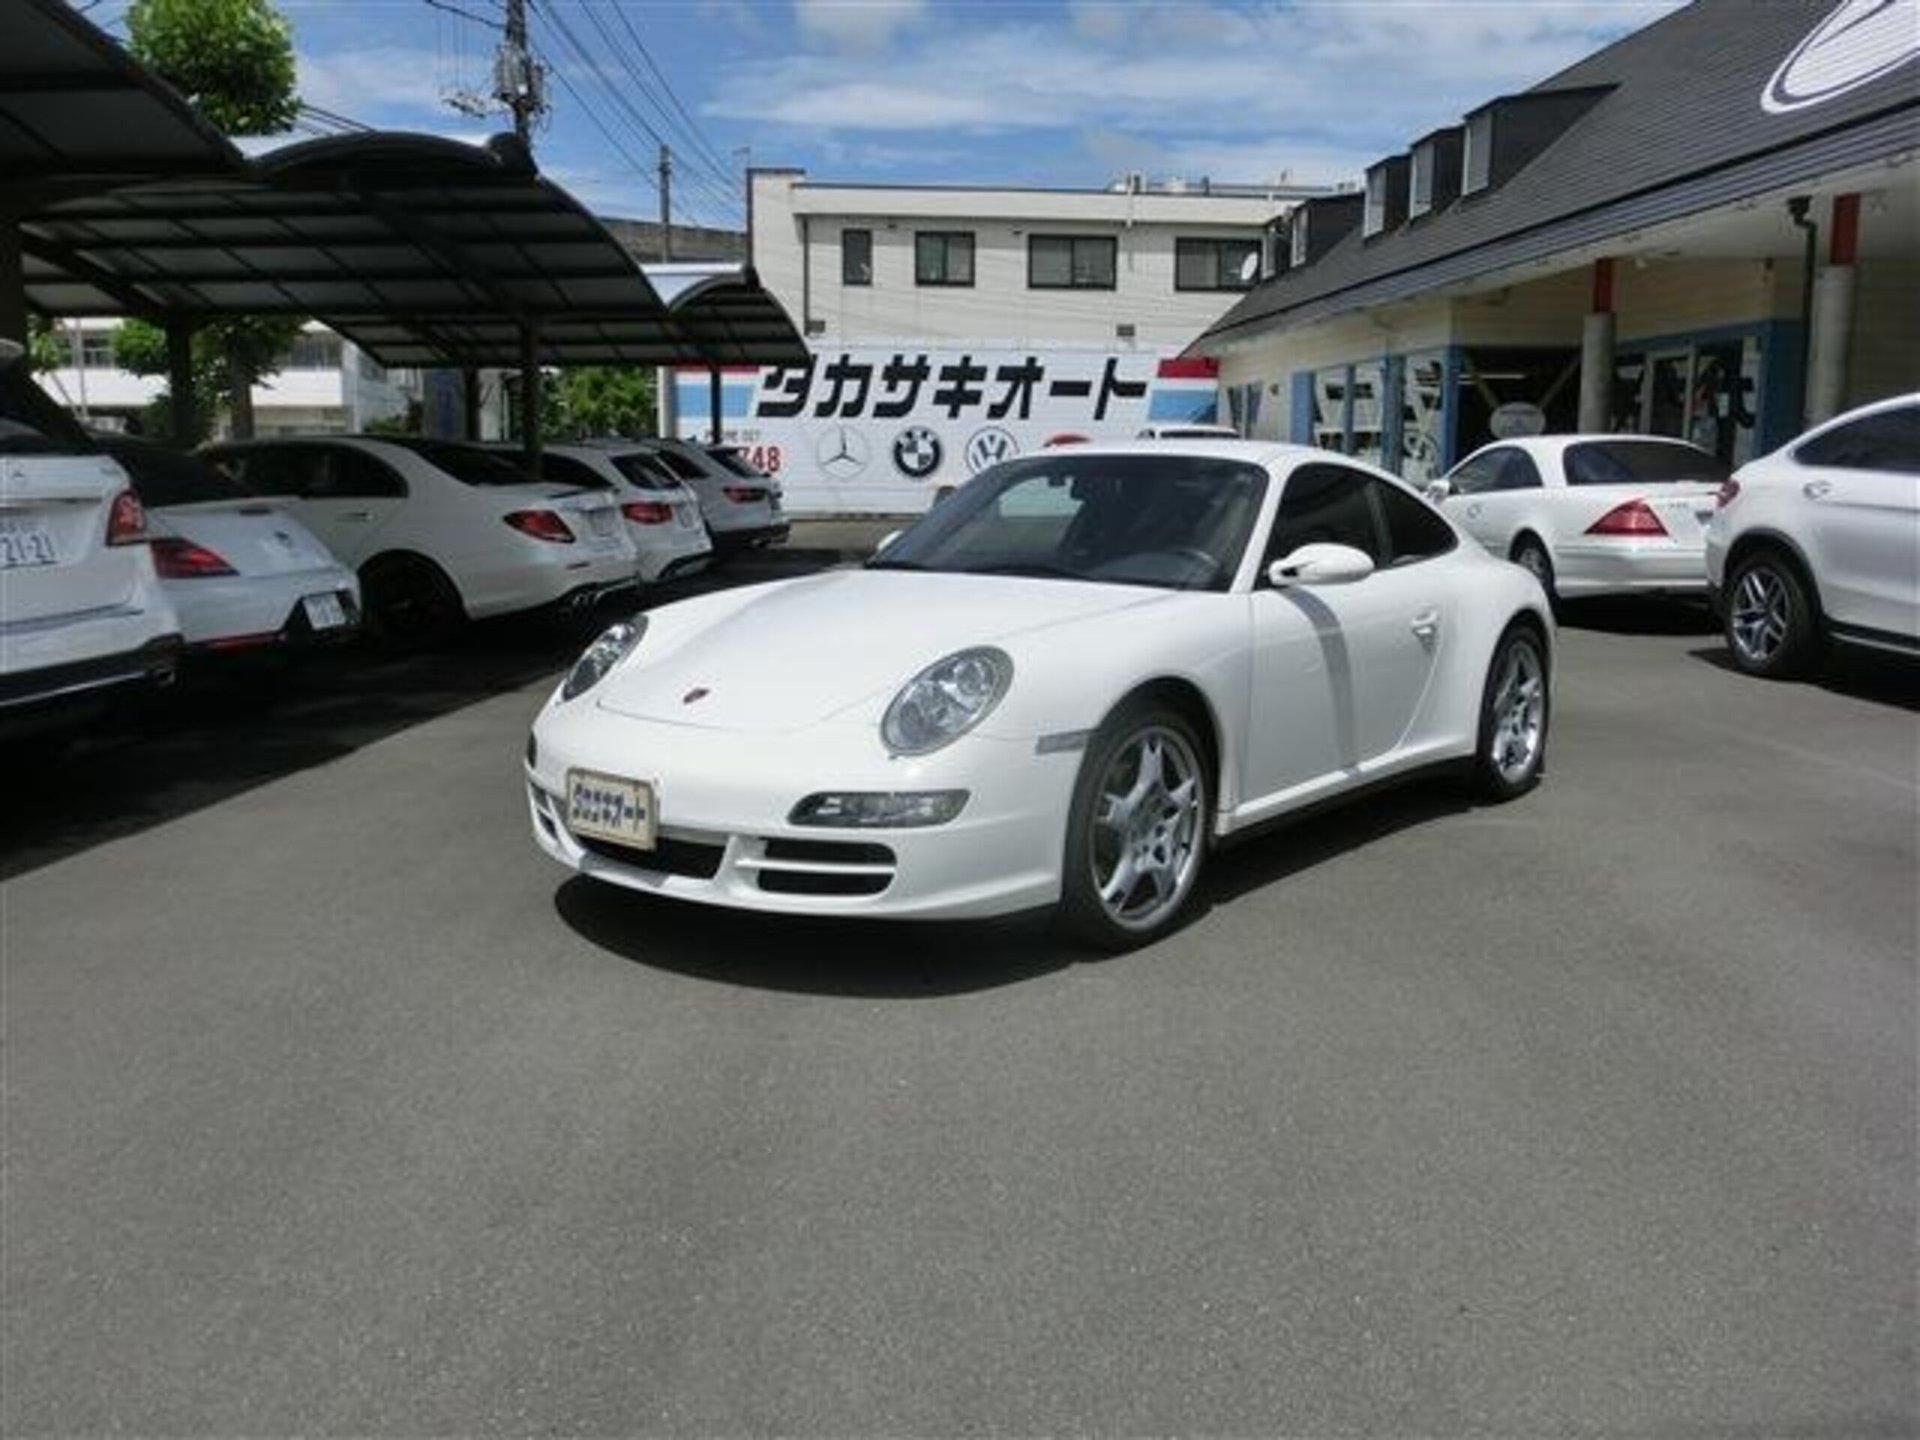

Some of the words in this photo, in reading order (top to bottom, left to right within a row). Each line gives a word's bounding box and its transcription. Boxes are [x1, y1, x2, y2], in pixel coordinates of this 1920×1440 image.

[756, 354, 1147, 420] タカサキオート
